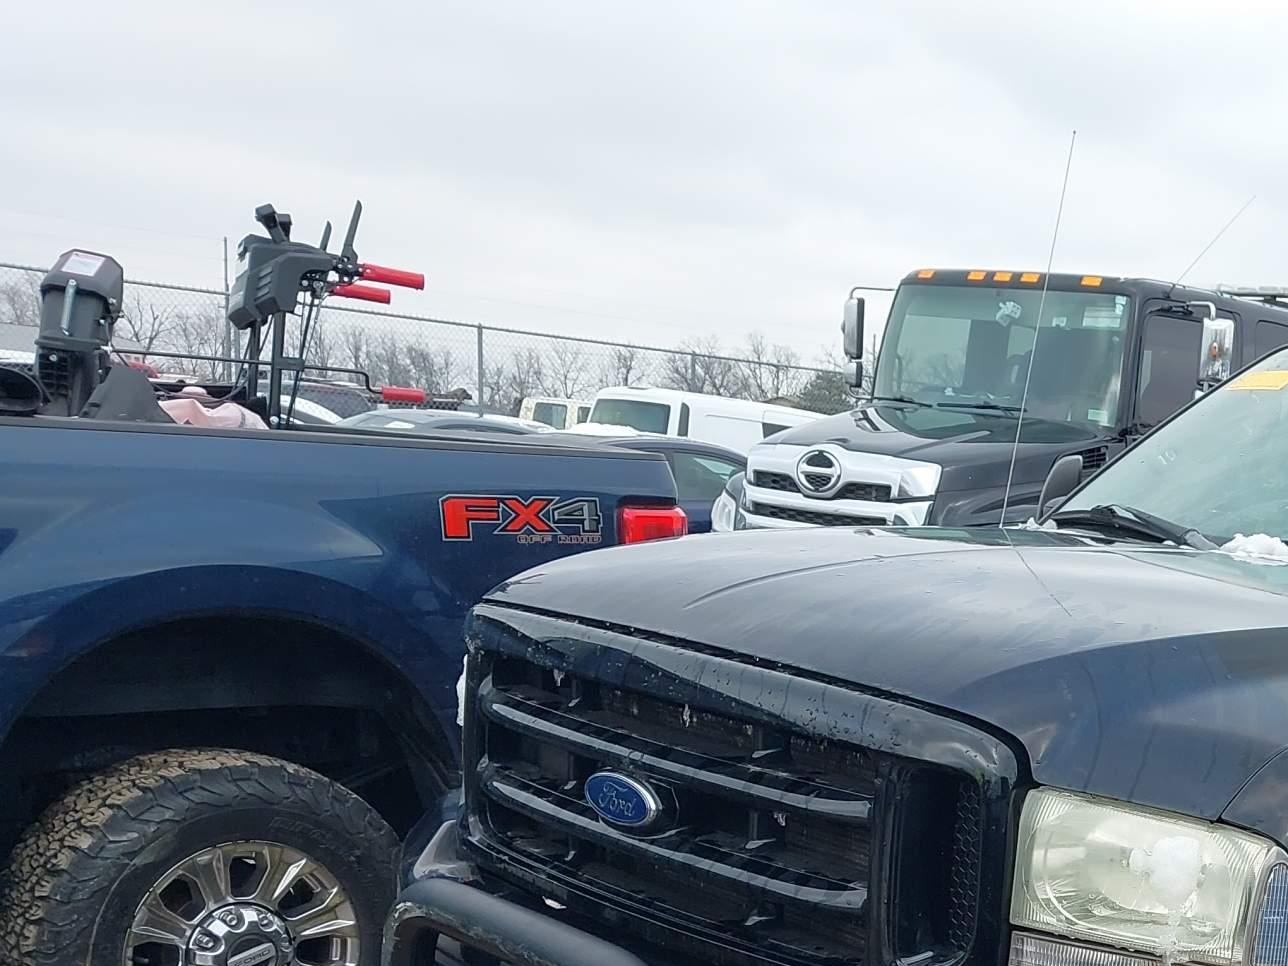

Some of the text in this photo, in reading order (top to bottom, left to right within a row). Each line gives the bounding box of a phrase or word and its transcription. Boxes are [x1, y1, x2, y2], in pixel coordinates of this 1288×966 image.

[439, 494, 603, 541] FX4
[516, 534, 602, 544] OFF ROAD
[598, 781, 638, 817] Ford
